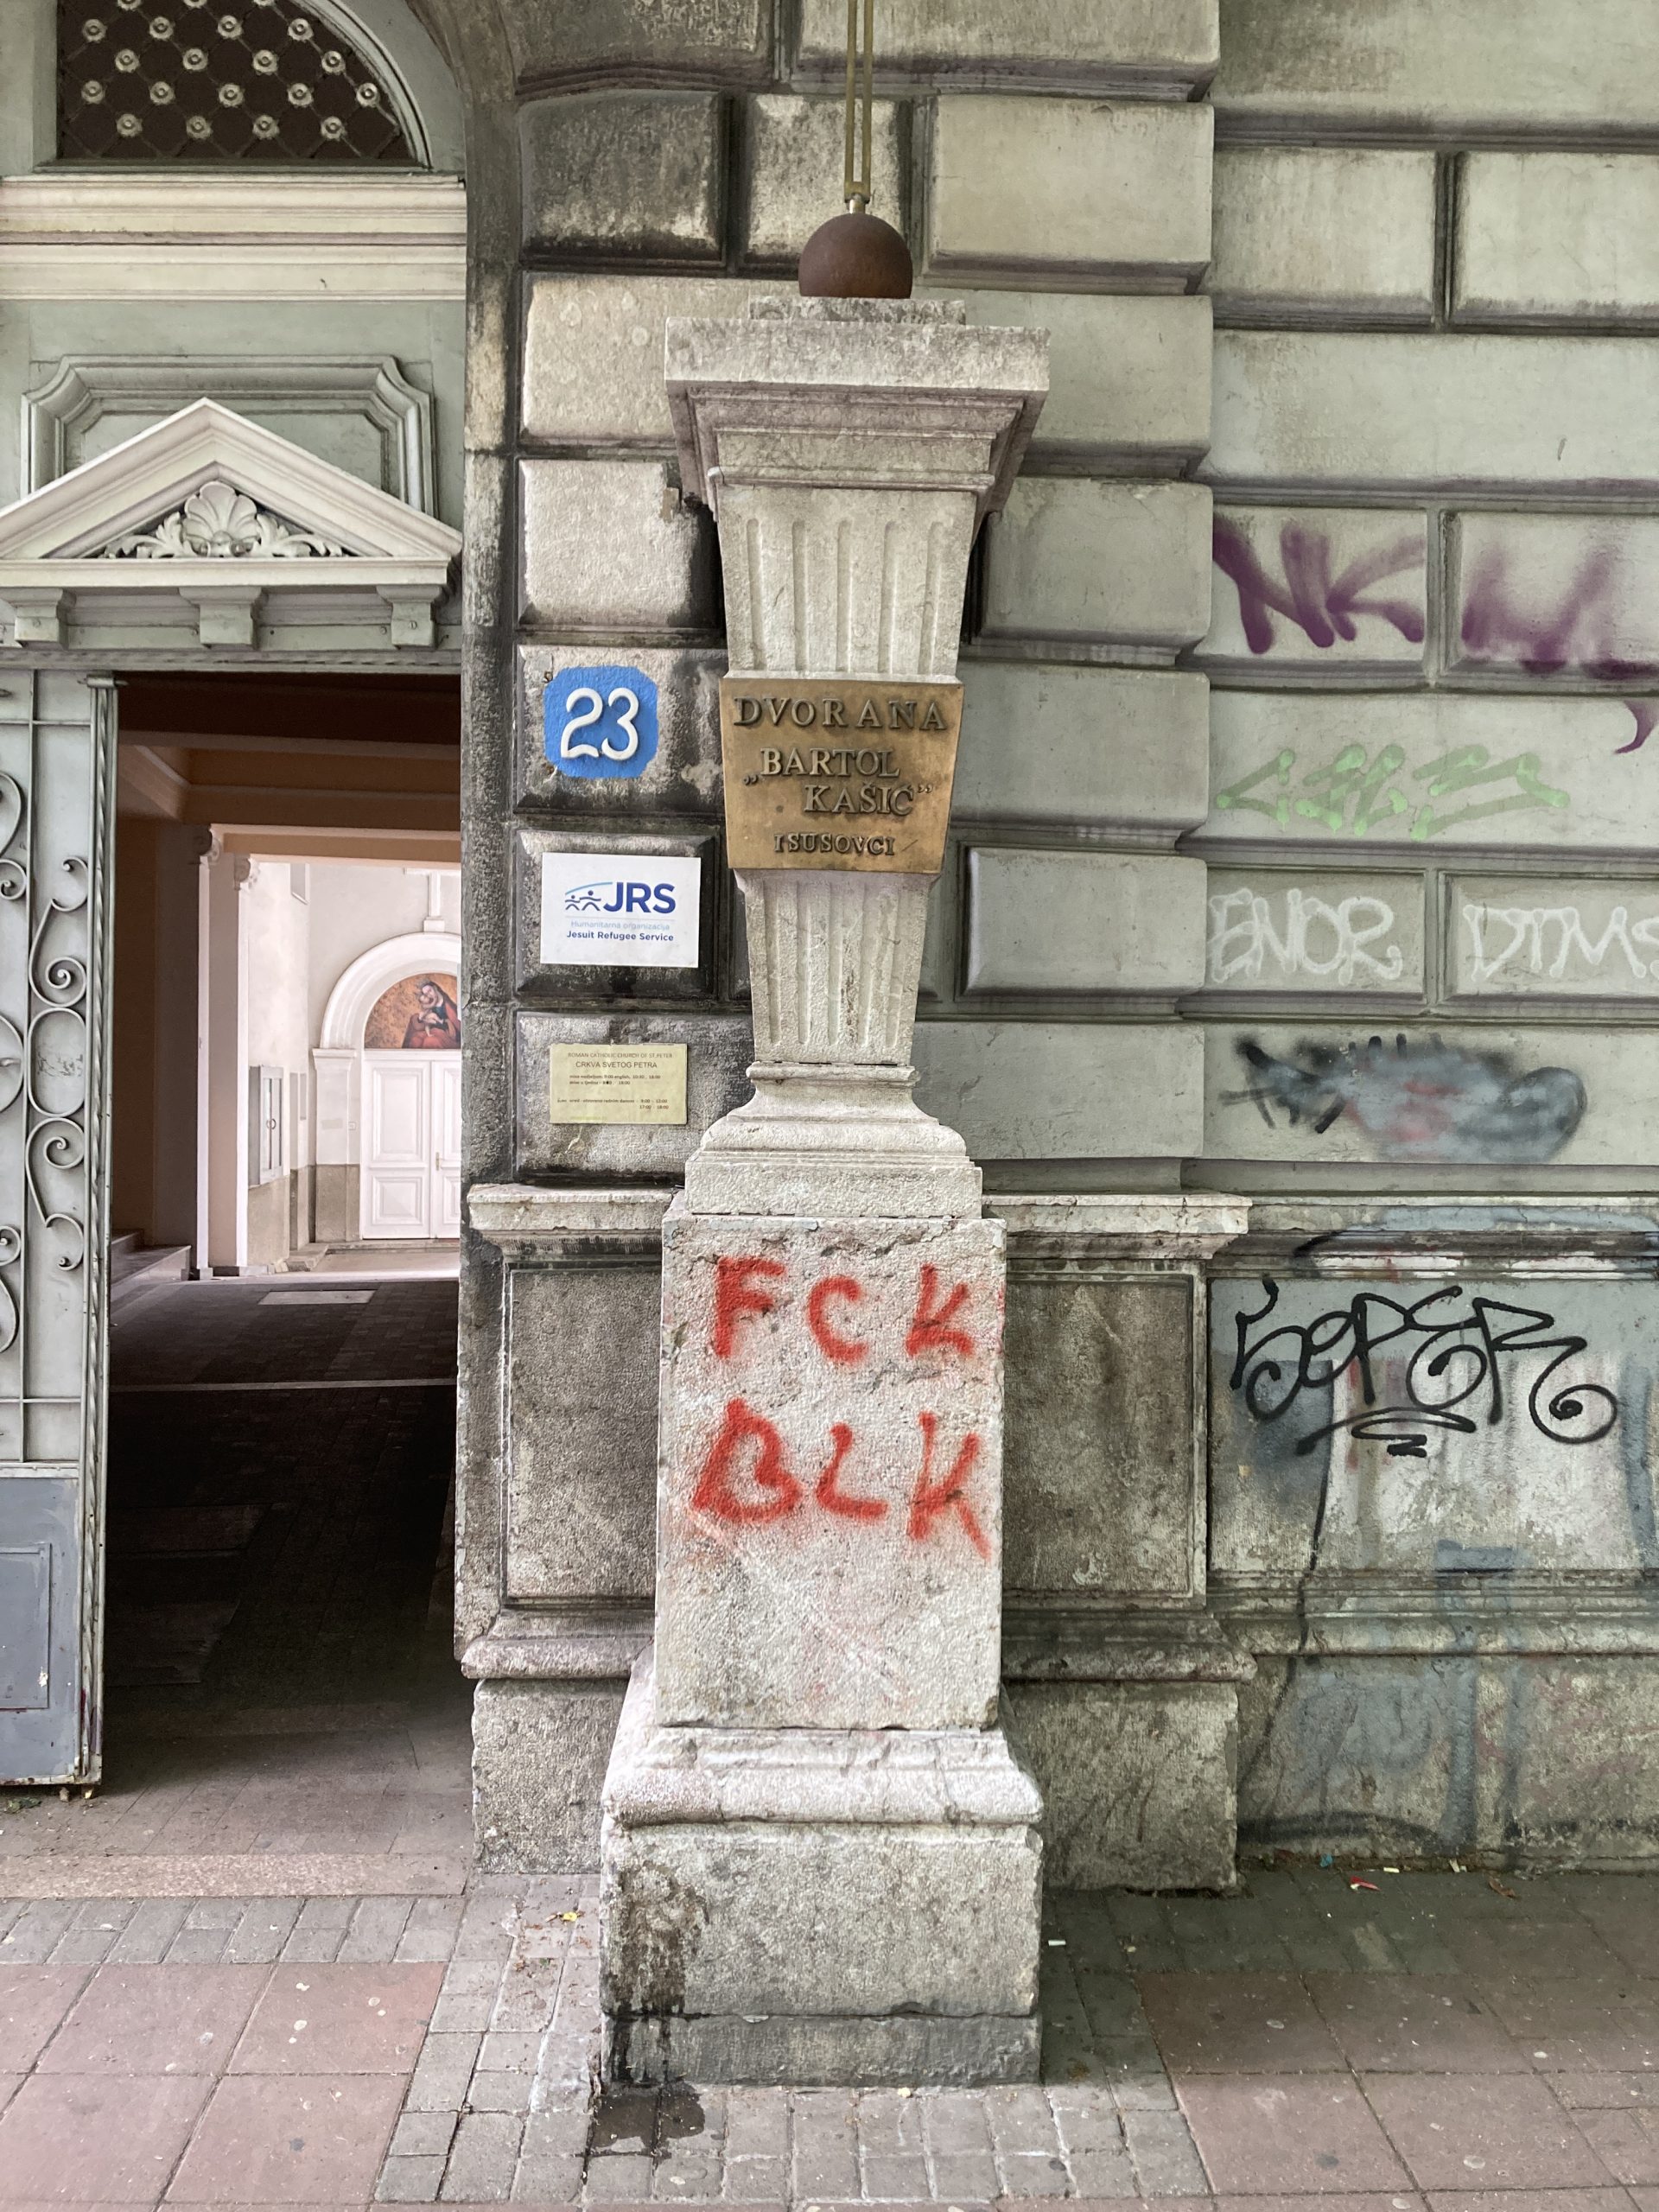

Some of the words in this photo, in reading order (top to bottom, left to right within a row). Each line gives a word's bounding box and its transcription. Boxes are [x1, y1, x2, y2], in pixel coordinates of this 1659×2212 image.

[561, 688, 639, 760] 23
[734, 697, 947, 730] DVORANA
[773, 832, 895, 855] ISUSOVCI
[603, 881, 677, 914] JRS
[566, 931, 594, 939] Jesuit
[597, 931, 637, 941] Refugee
[639, 933, 674, 942] Service
[570, 920, 621, 930] Humanitarna
[623, 922, 670, 931] organizacija
[714, 1256, 975, 1363] FCK
[692, 1397, 992, 1560] BLK
